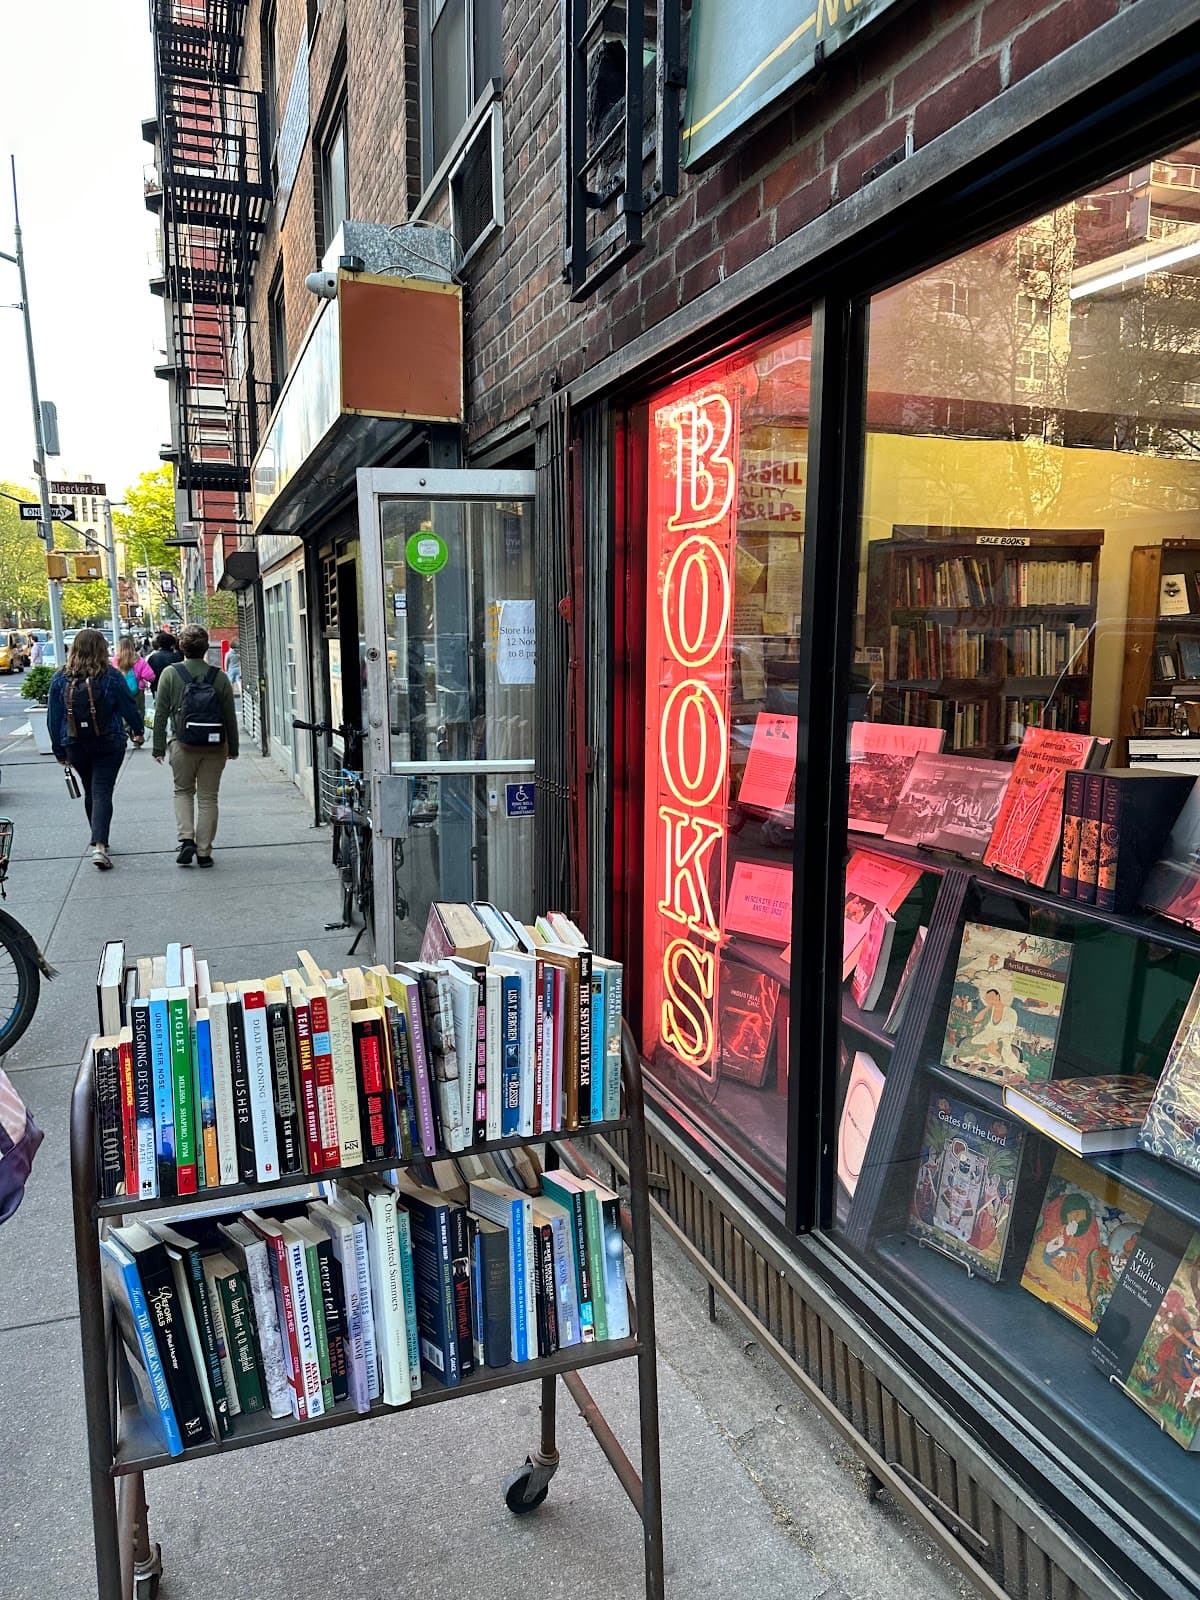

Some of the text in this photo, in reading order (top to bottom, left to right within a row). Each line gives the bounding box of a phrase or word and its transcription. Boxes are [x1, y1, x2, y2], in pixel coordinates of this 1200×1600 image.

[759, 459, 803, 485] SELL
[50, 483, 101, 494] Bleecker St
[740, 486, 788, 498] ALITY
[51, 509, 67, 517] WAY
[980, 536, 1026, 546] SALE BOOKS
[500, 624, 535, 635] Store Ho
[507, 638, 517, 646] 12
[509, 649, 524, 658] to 8
[657, 392, 735, 1067] BOOKS
[1041, 740, 1066, 751] American
[507, 989, 517, 1004] LISA
[580, 983, 589, 1005] THE
[731, 989, 761, 1002] INDUSTRIAL
[747, 999, 761, 1009] CHIC
[175, 1008, 184, 1053] PIGLET
[253, 1019, 261, 1044] DEAD
[274, 1028, 284, 1045] THE
[341, 1012, 352, 1043] ORDER
[507, 1012, 517, 1041] BERGREN
[580, 1008, 590, 1057] SEVENTH
[276, 1047, 286, 1068] DOGS
[332, 1030, 343, 1074] TRAFALGAR
[342, 1044, 352, 1054] OF
[135, 1011, 149, 1114] DESIGNING DESTINY
[255, 1045, 266, 1098] RECKONING
[278, 1070, 287, 1080] OF
[343, 1059, 356, 1090] BATTLE
[416, 1056, 424, 1078] SCARS
[580, 1059, 590, 1085] YEAR
[297, 1013, 317, 1143] TEAM HUMAN DOUGLAS RUSHKOFF
[235, 1079, 248, 1124] USHER
[279, 1083, 291, 1116] WINTER
[938, 1110, 1007, 1147] Gates of the Lord
[102, 1127, 120, 1172] LOOT
[292, 1246, 301, 1269] THE
[384, 1203, 401, 1312] One Hundred Summers
[1135, 1248, 1156, 1272] Holy
[319, 1256, 331, 1293] never
[357, 1262, 366, 1284] FIRST
[1129, 1260, 1165, 1295] Madness
[148, 1291, 166, 1327] NOVELS
[158, 1286, 173, 1324] BEFORE
[231, 1298, 243, 1313] Hard
[296, 1270, 309, 1323] SPLENDID
[324, 1297, 338, 1320] tell
[360, 1287, 369, 1315] BOSSES
[404, 1279, 413, 1314] VAMPIRES
[137, 1312, 149, 1331] THE
[303, 1325, 312, 1349] CITY
[364, 1340, 372, 1358] WILL
[140, 1331, 160, 1373] AMERICAN
[168, 1348, 178, 1370] Hunter
[335, 1336, 346, 1376] ALAFAIR
[312, 1362, 320, 1393] KAREN
[365, 1360, 376, 1392] HASKELL
[152, 1374, 170, 1411] NEWNESS
